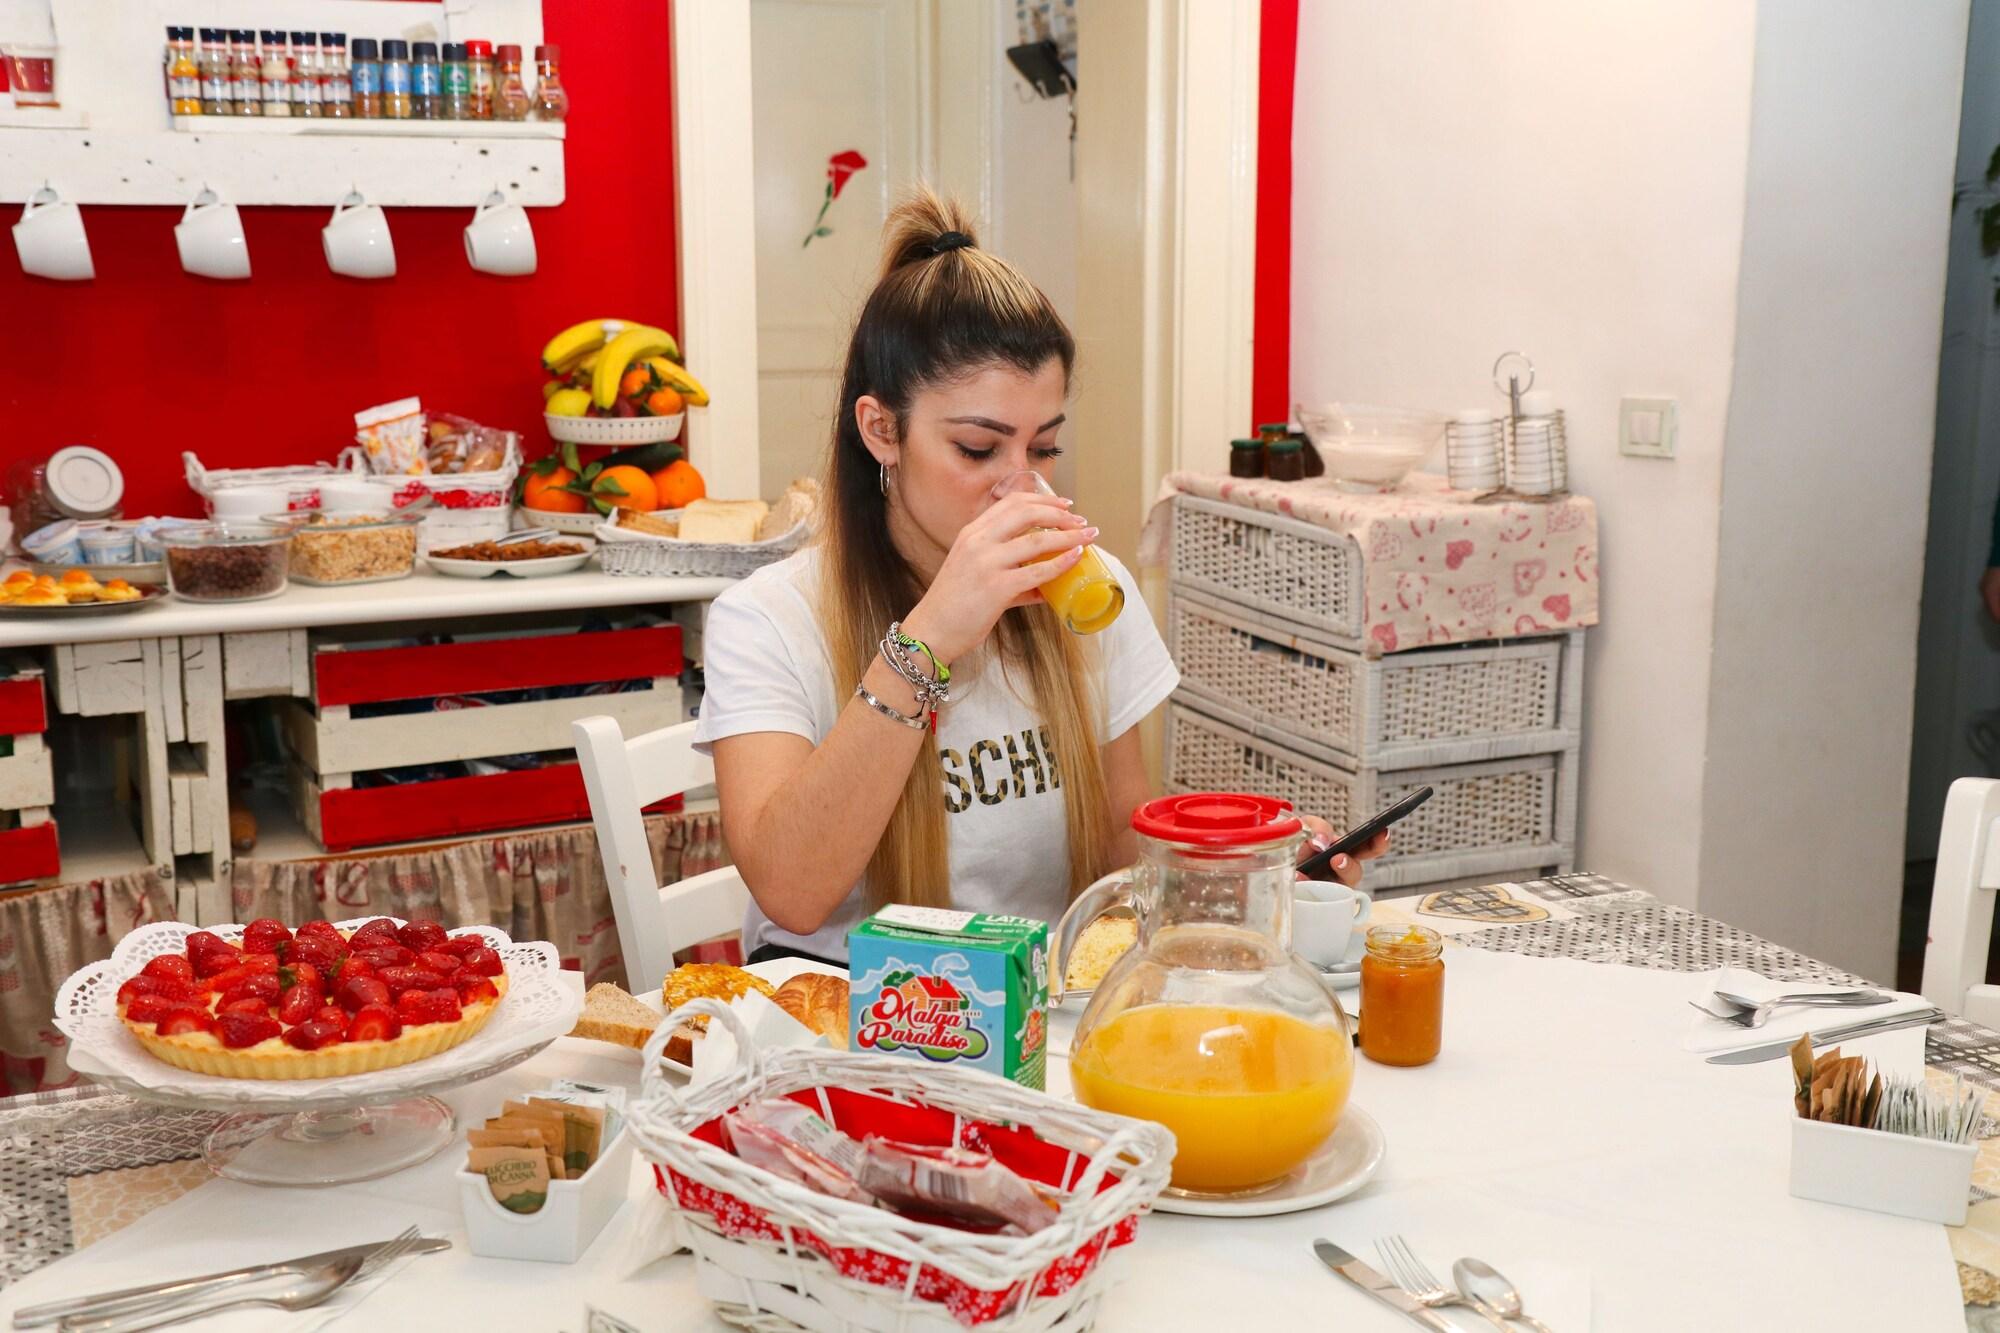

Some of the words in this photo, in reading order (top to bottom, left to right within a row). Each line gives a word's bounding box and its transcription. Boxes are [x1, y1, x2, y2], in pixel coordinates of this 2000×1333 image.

[871, 987, 962, 1032] Malga
[857, 1021, 968, 1050] Paradiso
[499, 1170, 537, 1183] CANNA
